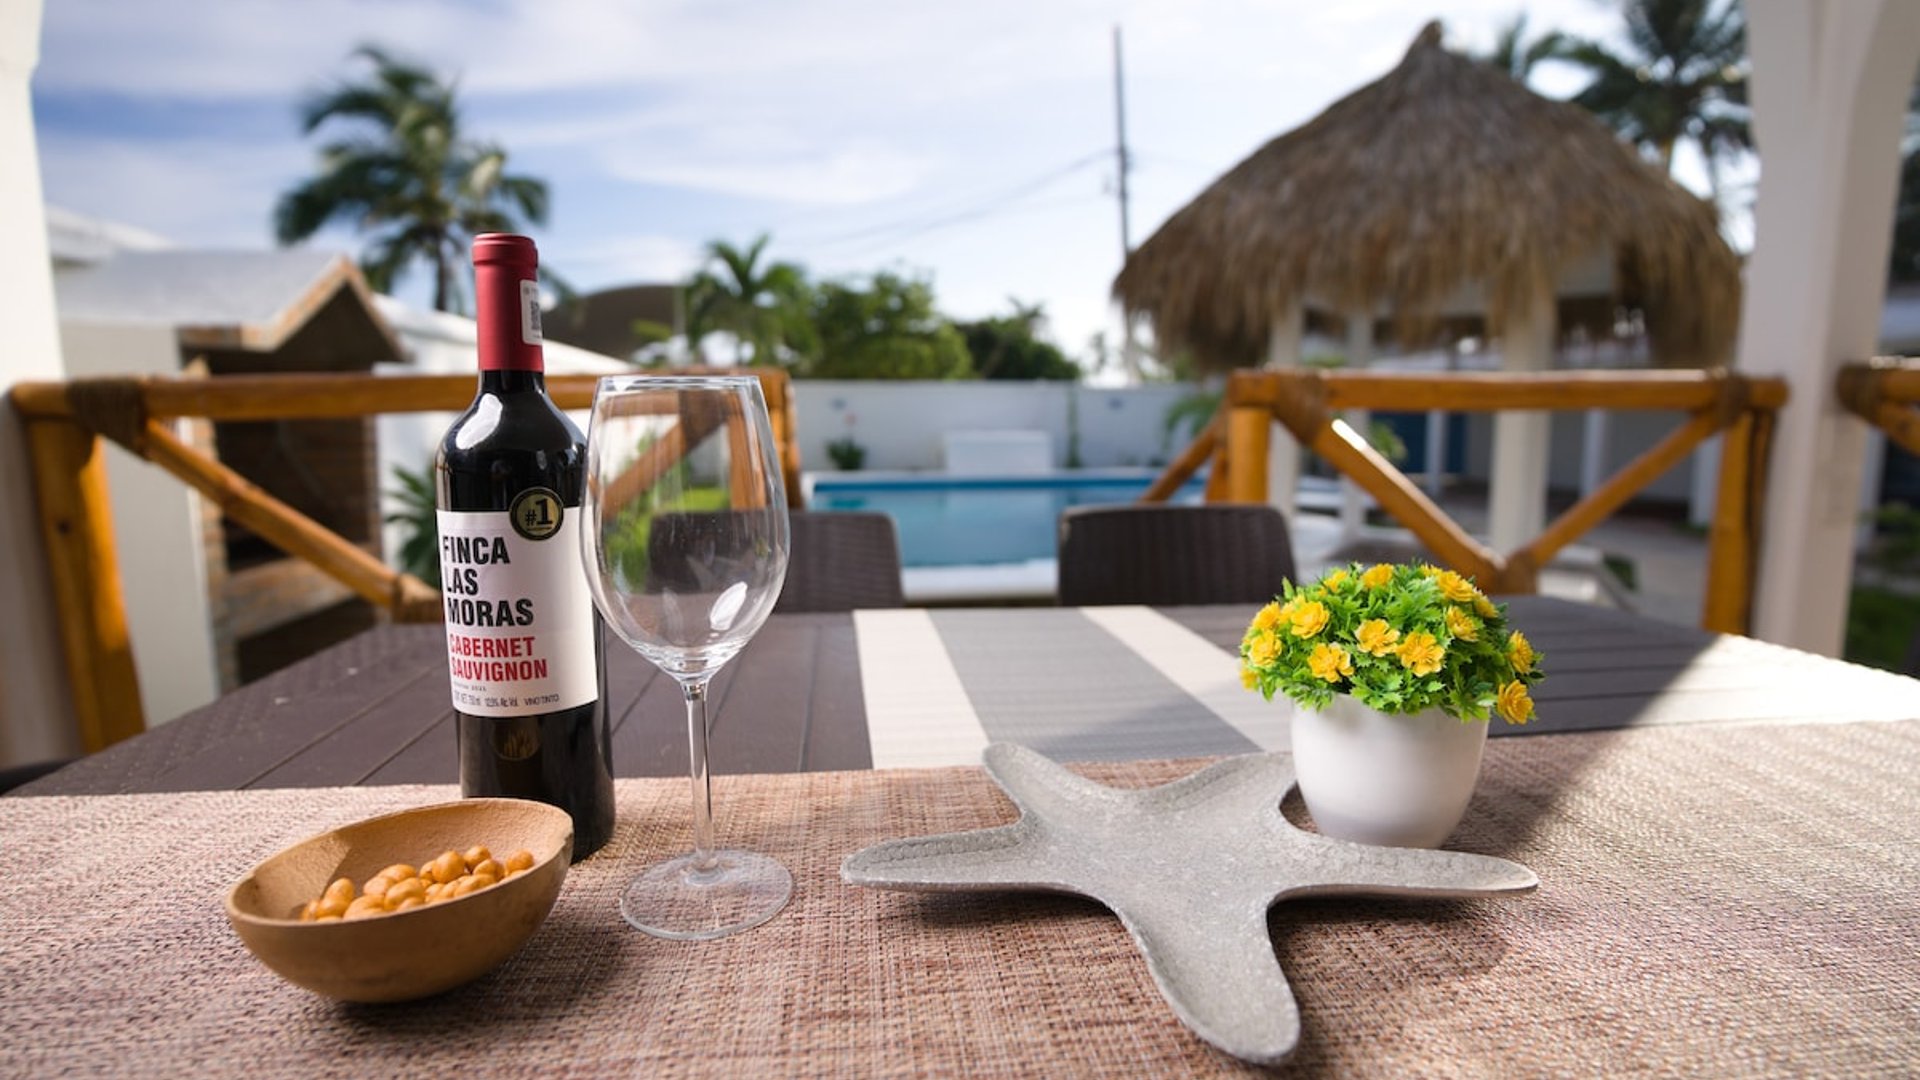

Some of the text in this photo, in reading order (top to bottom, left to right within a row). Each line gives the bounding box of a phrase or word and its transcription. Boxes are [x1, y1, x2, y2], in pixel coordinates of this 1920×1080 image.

[525, 498, 553, 526] #1
[443, 536, 510, 565] FINCA
[446, 566, 478, 595] LAS
[447, 598, 534, 626] MORAS
[450, 634, 535, 658] CABERNET
[451, 657, 547, 681] SAUVIGNON
